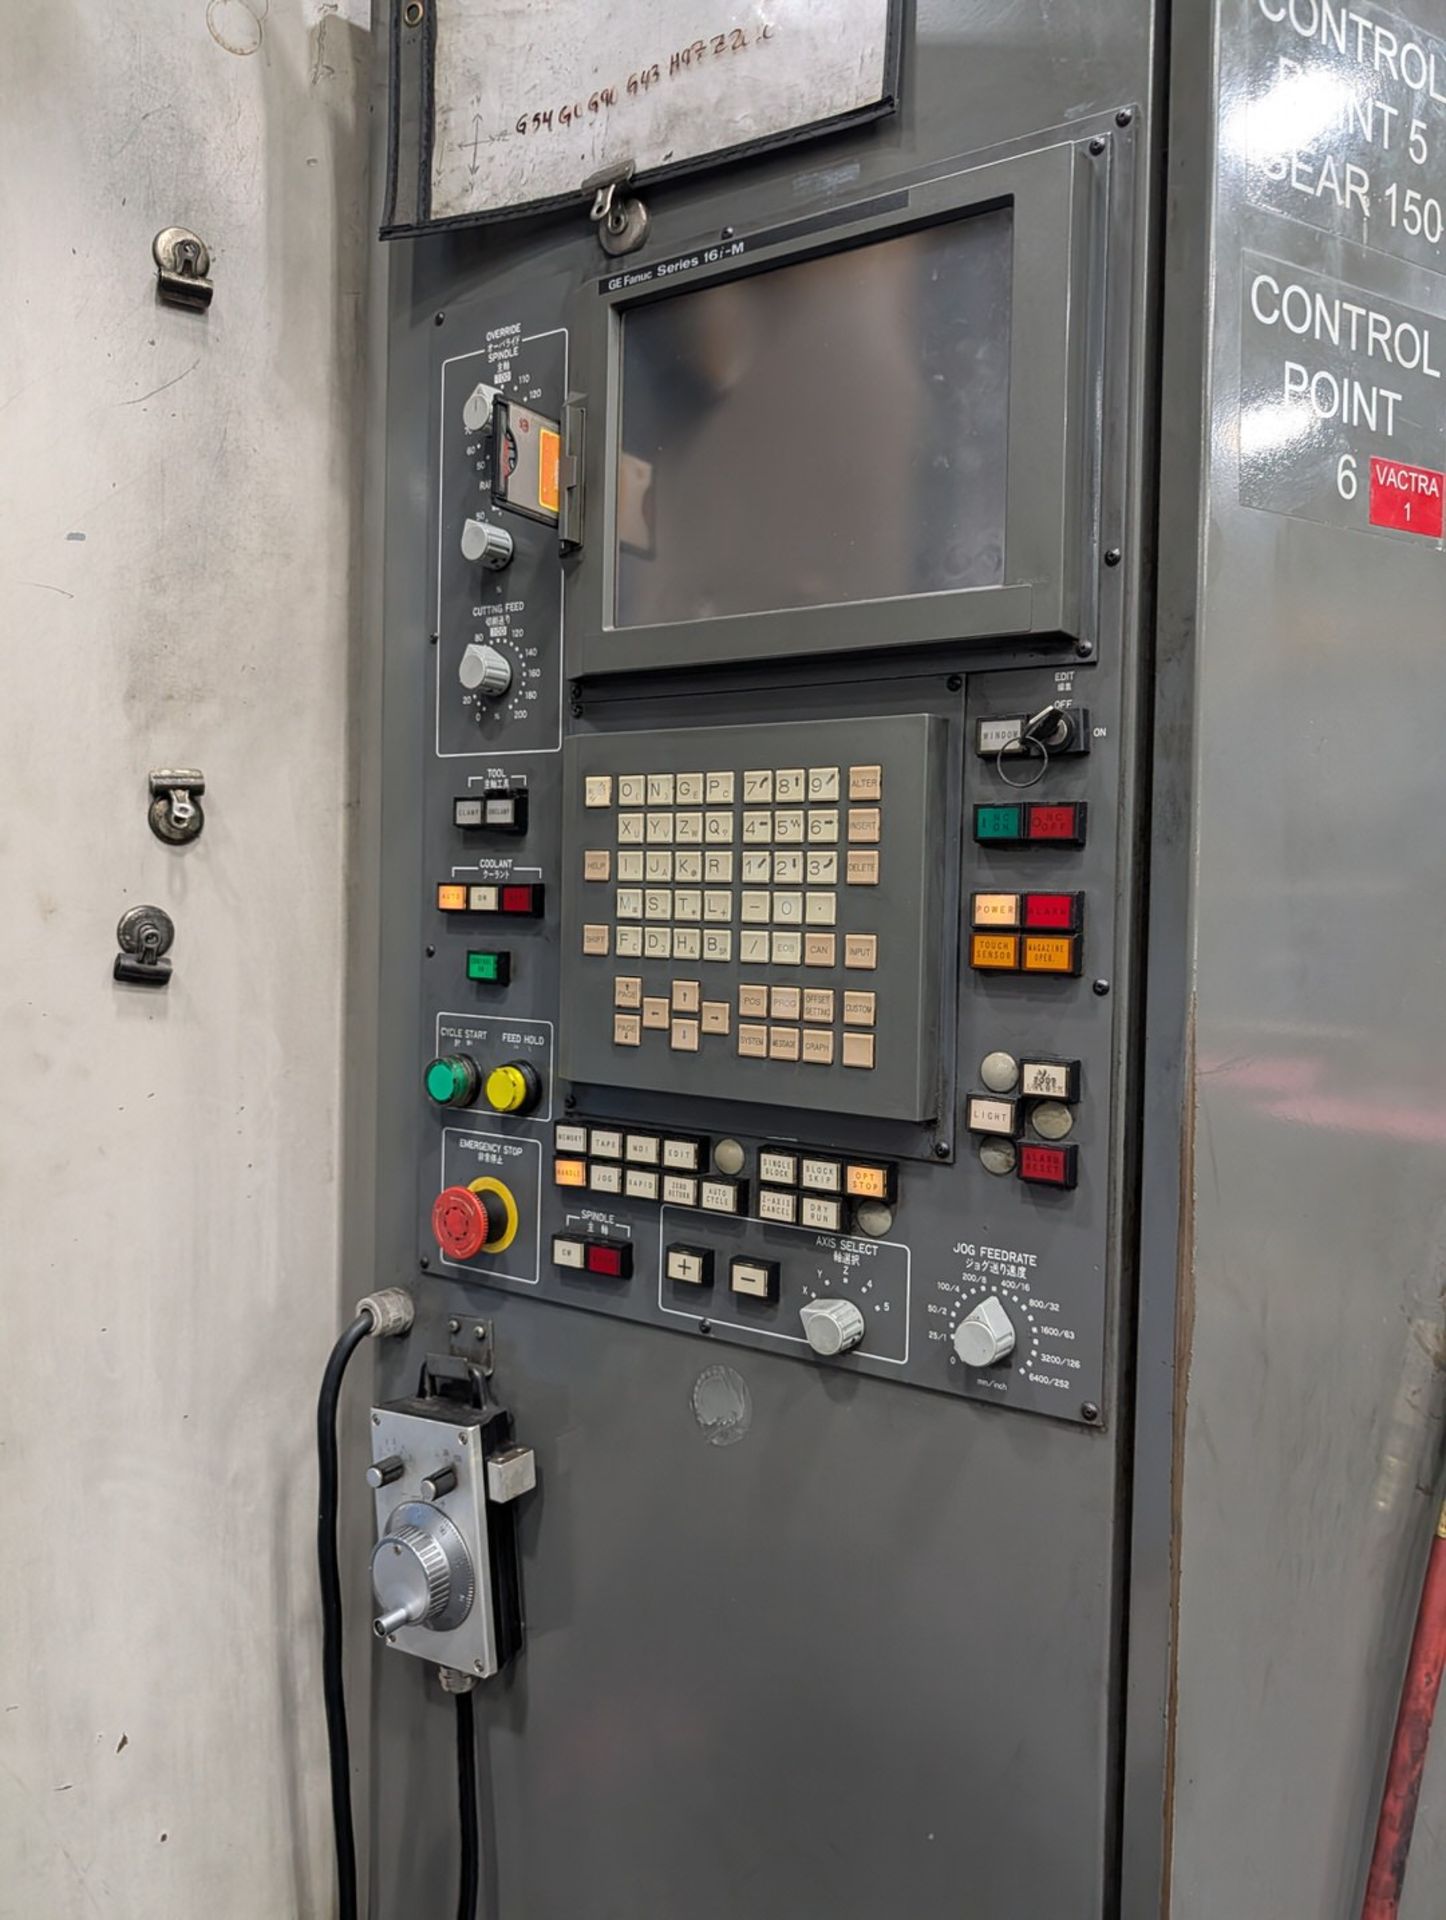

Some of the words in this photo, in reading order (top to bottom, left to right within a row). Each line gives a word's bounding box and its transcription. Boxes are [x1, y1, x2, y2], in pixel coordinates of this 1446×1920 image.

[516, 109, 553, 135] G54
[626, 64, 660, 96] G43
[1409, 118, 1427, 164] 5
[1385, 182, 1442, 243] 150
[608, 277, 622, 291] GE
[624, 270, 653, 287] Fanuc
[656, 256, 699, 277] Series
[486, 323, 521, 341] OVERRIDE
[1251, 275, 1441, 378] CONTROL
[488, 346, 519, 363] SPINDLE
[1284, 360, 1403, 436] POINT
[1337, 454, 1357, 499] 6
[1375, 463, 1440, 498] VACTRA
[1404, 502, 1411, 521] 1
[472, 604, 503, 616] CUTTING
[505, 601, 525, 612] FEED
[525, 647, 538, 657] 140
[1055, 671, 1075, 682] EDIT
[1054, 700, 1073, 709] OFF
[983, 730, 1018, 740] WINDOW
[1093, 727, 1107, 737] ON
[487, 768, 507, 778] TOOL
[650, 783, 660, 796] N
[679, 781, 691, 796] G
[709, 780, 720, 793] P
[747, 781, 757, 795] 7
[778, 779, 790, 793] 8
[811, 778, 822, 792] 9
[851, 779, 876, 788] ALTER
[621, 821, 631, 834] X
[650, 820, 660, 833] Y
[680, 820, 689, 834] Z
[708, 819, 719, 835] Q
[746, 821, 755, 835] 4
[778, 820, 788, 834] 5
[811, 820, 821, 834] 6
[851, 821, 876, 829] INSERT
[479, 859, 513, 868] COOLANT
[650, 860, 659, 872] J
[679, 859, 688, 872] K
[709, 859, 720, 873] R
[777, 861, 787, 875] 2
[809, 861, 820, 875] 3
[849, 863, 875, 872] DELETE
[619, 896, 631, 909] M
[649, 897, 658, 910] S
[679, 898, 688, 911] T
[708, 899, 716, 912] L
[976, 905, 1014, 914] POWER
[620, 933, 628, 946] F
[649, 935, 658, 948] D
[677, 936, 687, 949] H
[708, 937, 717, 951] B
[980, 941, 1009, 949] TOUCH
[810, 946, 828, 954] CAN
[850, 948, 871, 956] INPUT
[977, 950, 1011, 960] SENSOR
[744, 997, 760, 1006] POS
[774, 998, 796, 1008] PROG
[846, 1005, 872, 1013] CUSTOM
[441, 1027, 462, 1038] CYCLE
[464, 1030, 488, 1040] START
[502, 1033, 522, 1043] FEED
[523, 1035, 544, 1046] HOLD
[805, 1042, 829, 1051] GRAPH
[973, 1111, 1006, 1121] LIGHT
[459, 1138, 502, 1154] EMERGENCY
[503, 1145, 523, 1156] STOP
[668, 1150, 690, 1159] EDIT
[806, 1166, 833, 1175] BLOCK
[855, 1172, 874, 1182] OPT
[808, 1174, 831, 1184] SKIP
[852, 1181, 878, 1191] STOP
[708, 1188, 727, 1198] AUTO
[810, 1203, 828, 1213] DRY
[581, 1209, 615, 1225] SPINDLE
[810, 1213, 829, 1223] RUN
[816, 1236, 837, 1248] AXIS
[840, 1240, 879, 1256] SELECT
[953, 1242, 976, 1256] JOG
[980, 1246, 1038, 1267] FEEDRATE
[817, 1269, 823, 1279] Y
[843, 1265, 849, 1275] Z
[867, 1279, 873, 1288] 4
[937, 1281, 960, 1293] 100/4
[1001, 1279, 1031, 1292] 400/16
[803, 1286, 808, 1295] X
[883, 1302, 890, 1311] 5
[928, 1330, 947, 1342] 25/1
